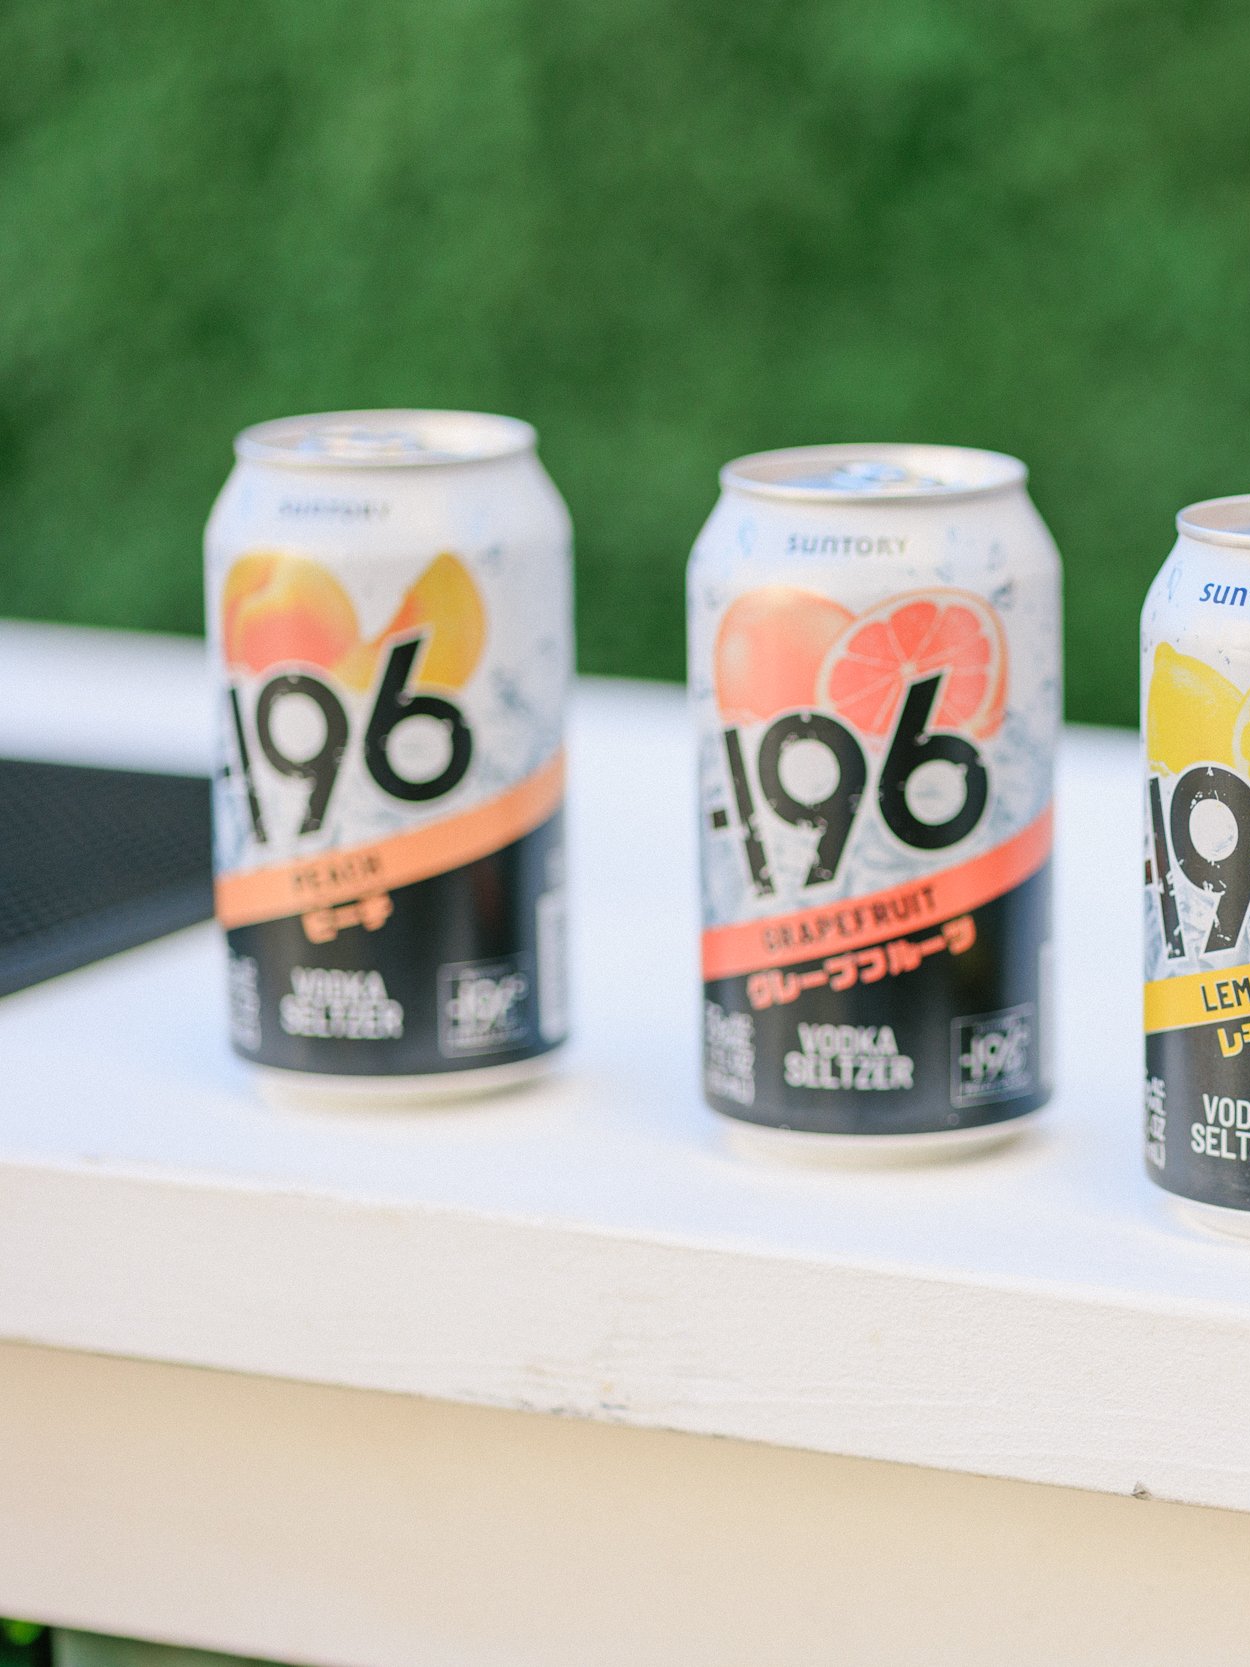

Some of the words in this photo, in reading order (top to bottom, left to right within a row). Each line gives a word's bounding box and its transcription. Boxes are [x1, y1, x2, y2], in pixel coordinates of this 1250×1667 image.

[712, 674, 988, 897] -196
[763, 885, 937, 951] GRAPEFRUIT
[797, 1022, 899, 1056] VODKA
[784, 1051, 914, 1090] SELTZER
